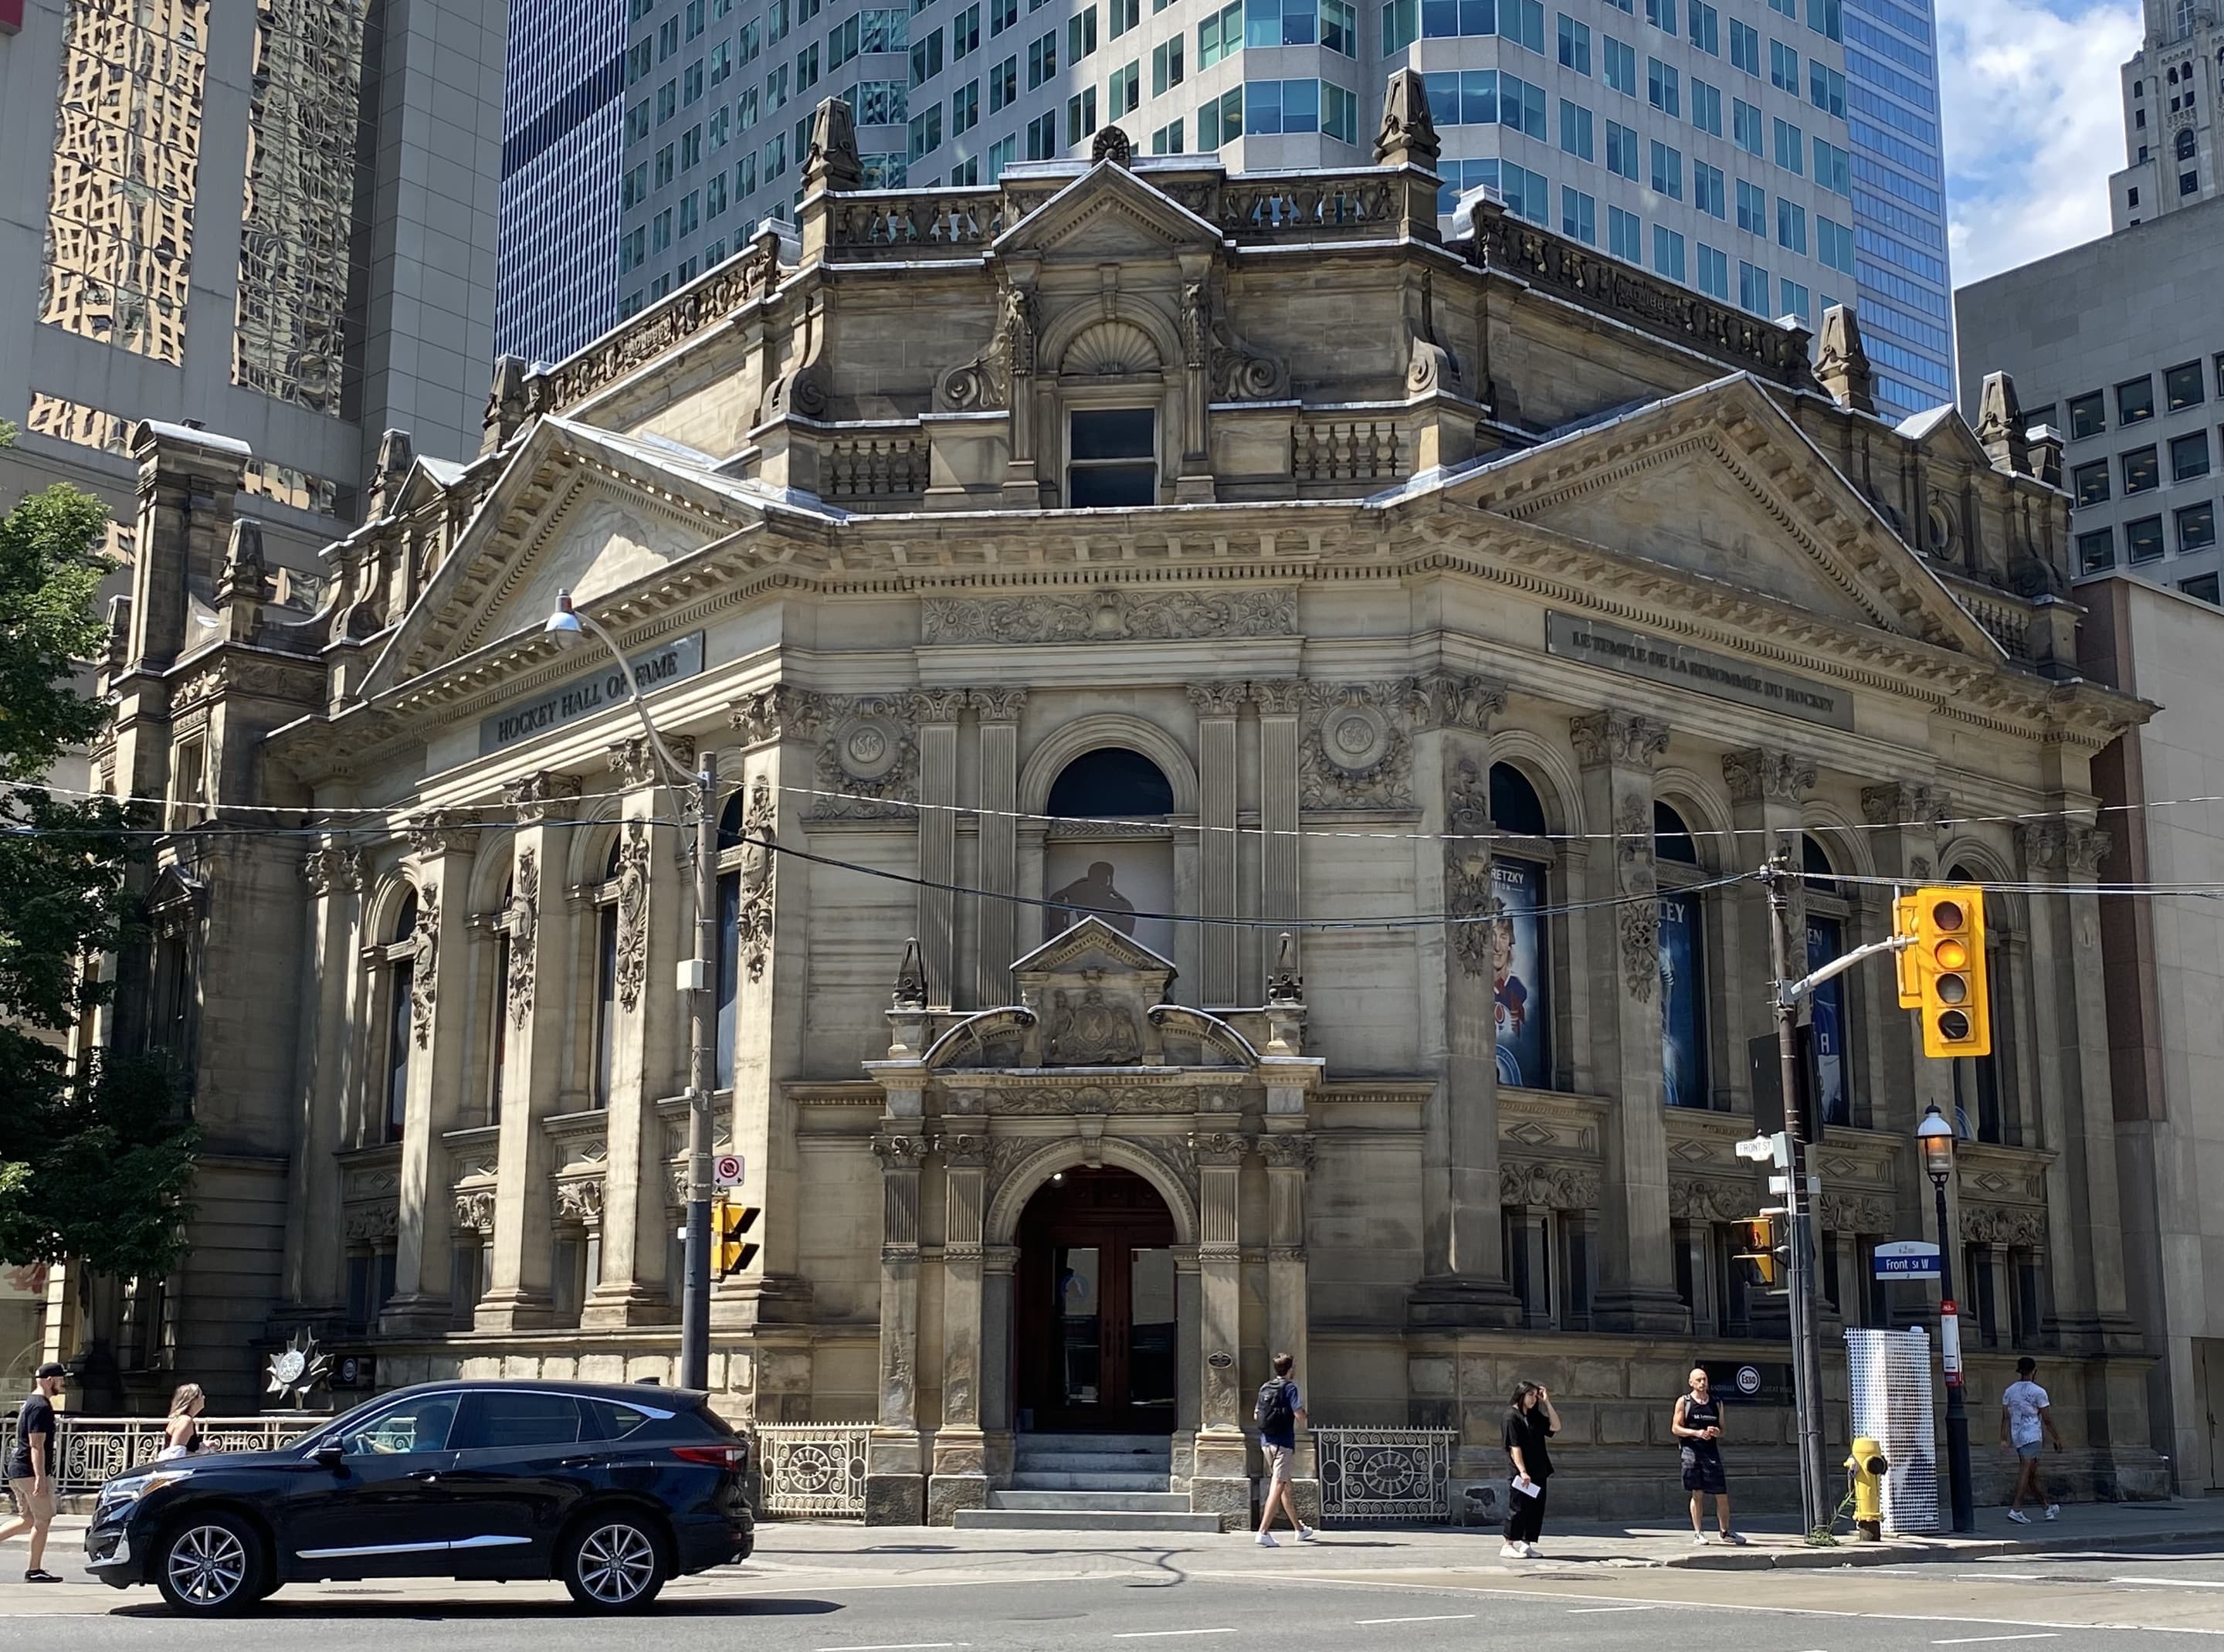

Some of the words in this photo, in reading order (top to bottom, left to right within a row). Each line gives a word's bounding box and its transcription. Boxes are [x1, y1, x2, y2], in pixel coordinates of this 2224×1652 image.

[1572, 631, 1591, 648] LE
[1591, 636, 1647, 663] TEMPLE
[1648, 650, 1668, 668] DE
[1670, 656, 1687, 673] LA
[1688, 661, 1762, 693] RENOMMÉE
[1764, 681, 1783, 698] DU
[1785, 687, 1834, 713] HOCKEY
[497, 700, 557, 743] HOCKEY
[560, 683, 602, 718] HALL
[606, 672, 629, 699] OF
[635, 652, 678, 689] FAME
[1491, 868, 1524, 884] RETZKY
[1656, 902, 1685, 923] LEY
[1739, 1143, 1761, 1153] FRONT
[1762, 1141, 1771, 1151] ST
[1886, 1259, 1908, 1270] Front
[1921, 1259, 1929, 1269] W
